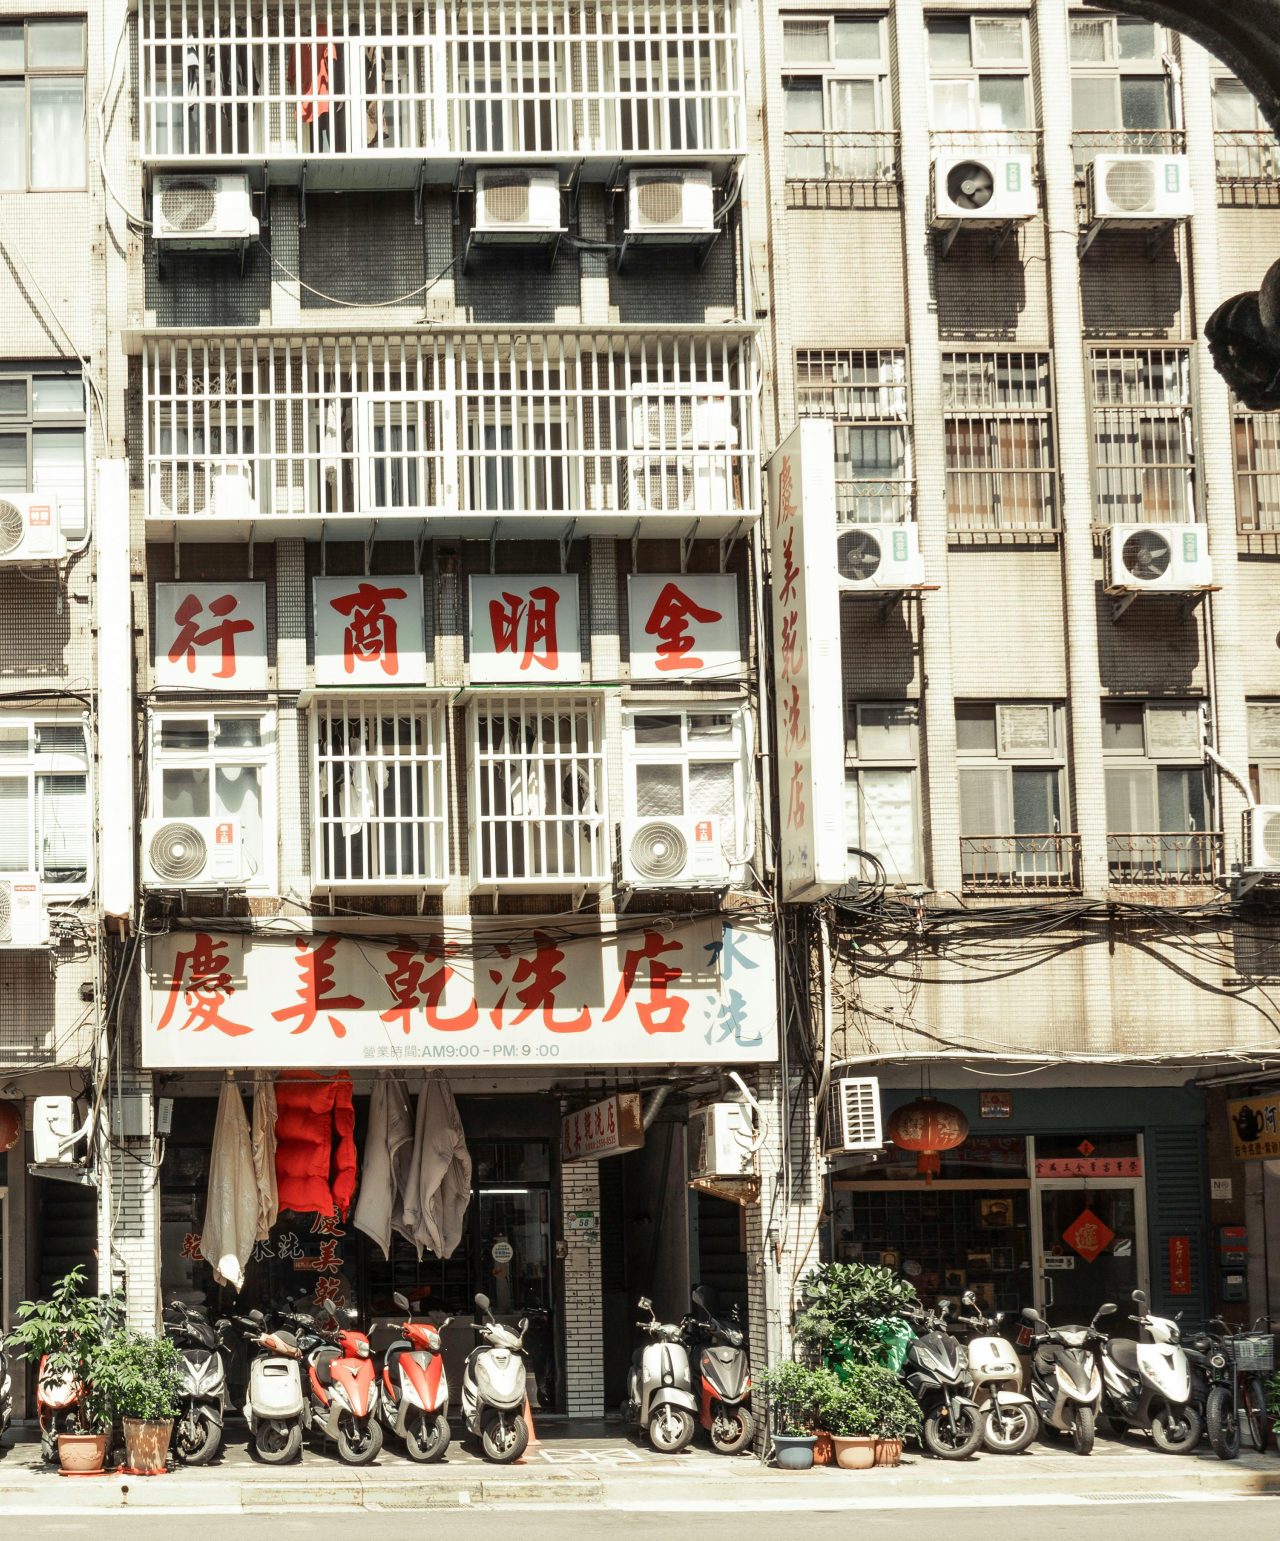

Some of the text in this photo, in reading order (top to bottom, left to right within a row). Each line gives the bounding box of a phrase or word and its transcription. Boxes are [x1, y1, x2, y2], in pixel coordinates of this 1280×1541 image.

[775, 454, 808, 833] 慶美乾洗店
[157, 928, 692, 1039] 慶美乾洗店
[703, 920, 764, 1047] 水洗
[309, 1206, 346, 1332] 慶美乾
[578, 1218, 590, 1227] 58
